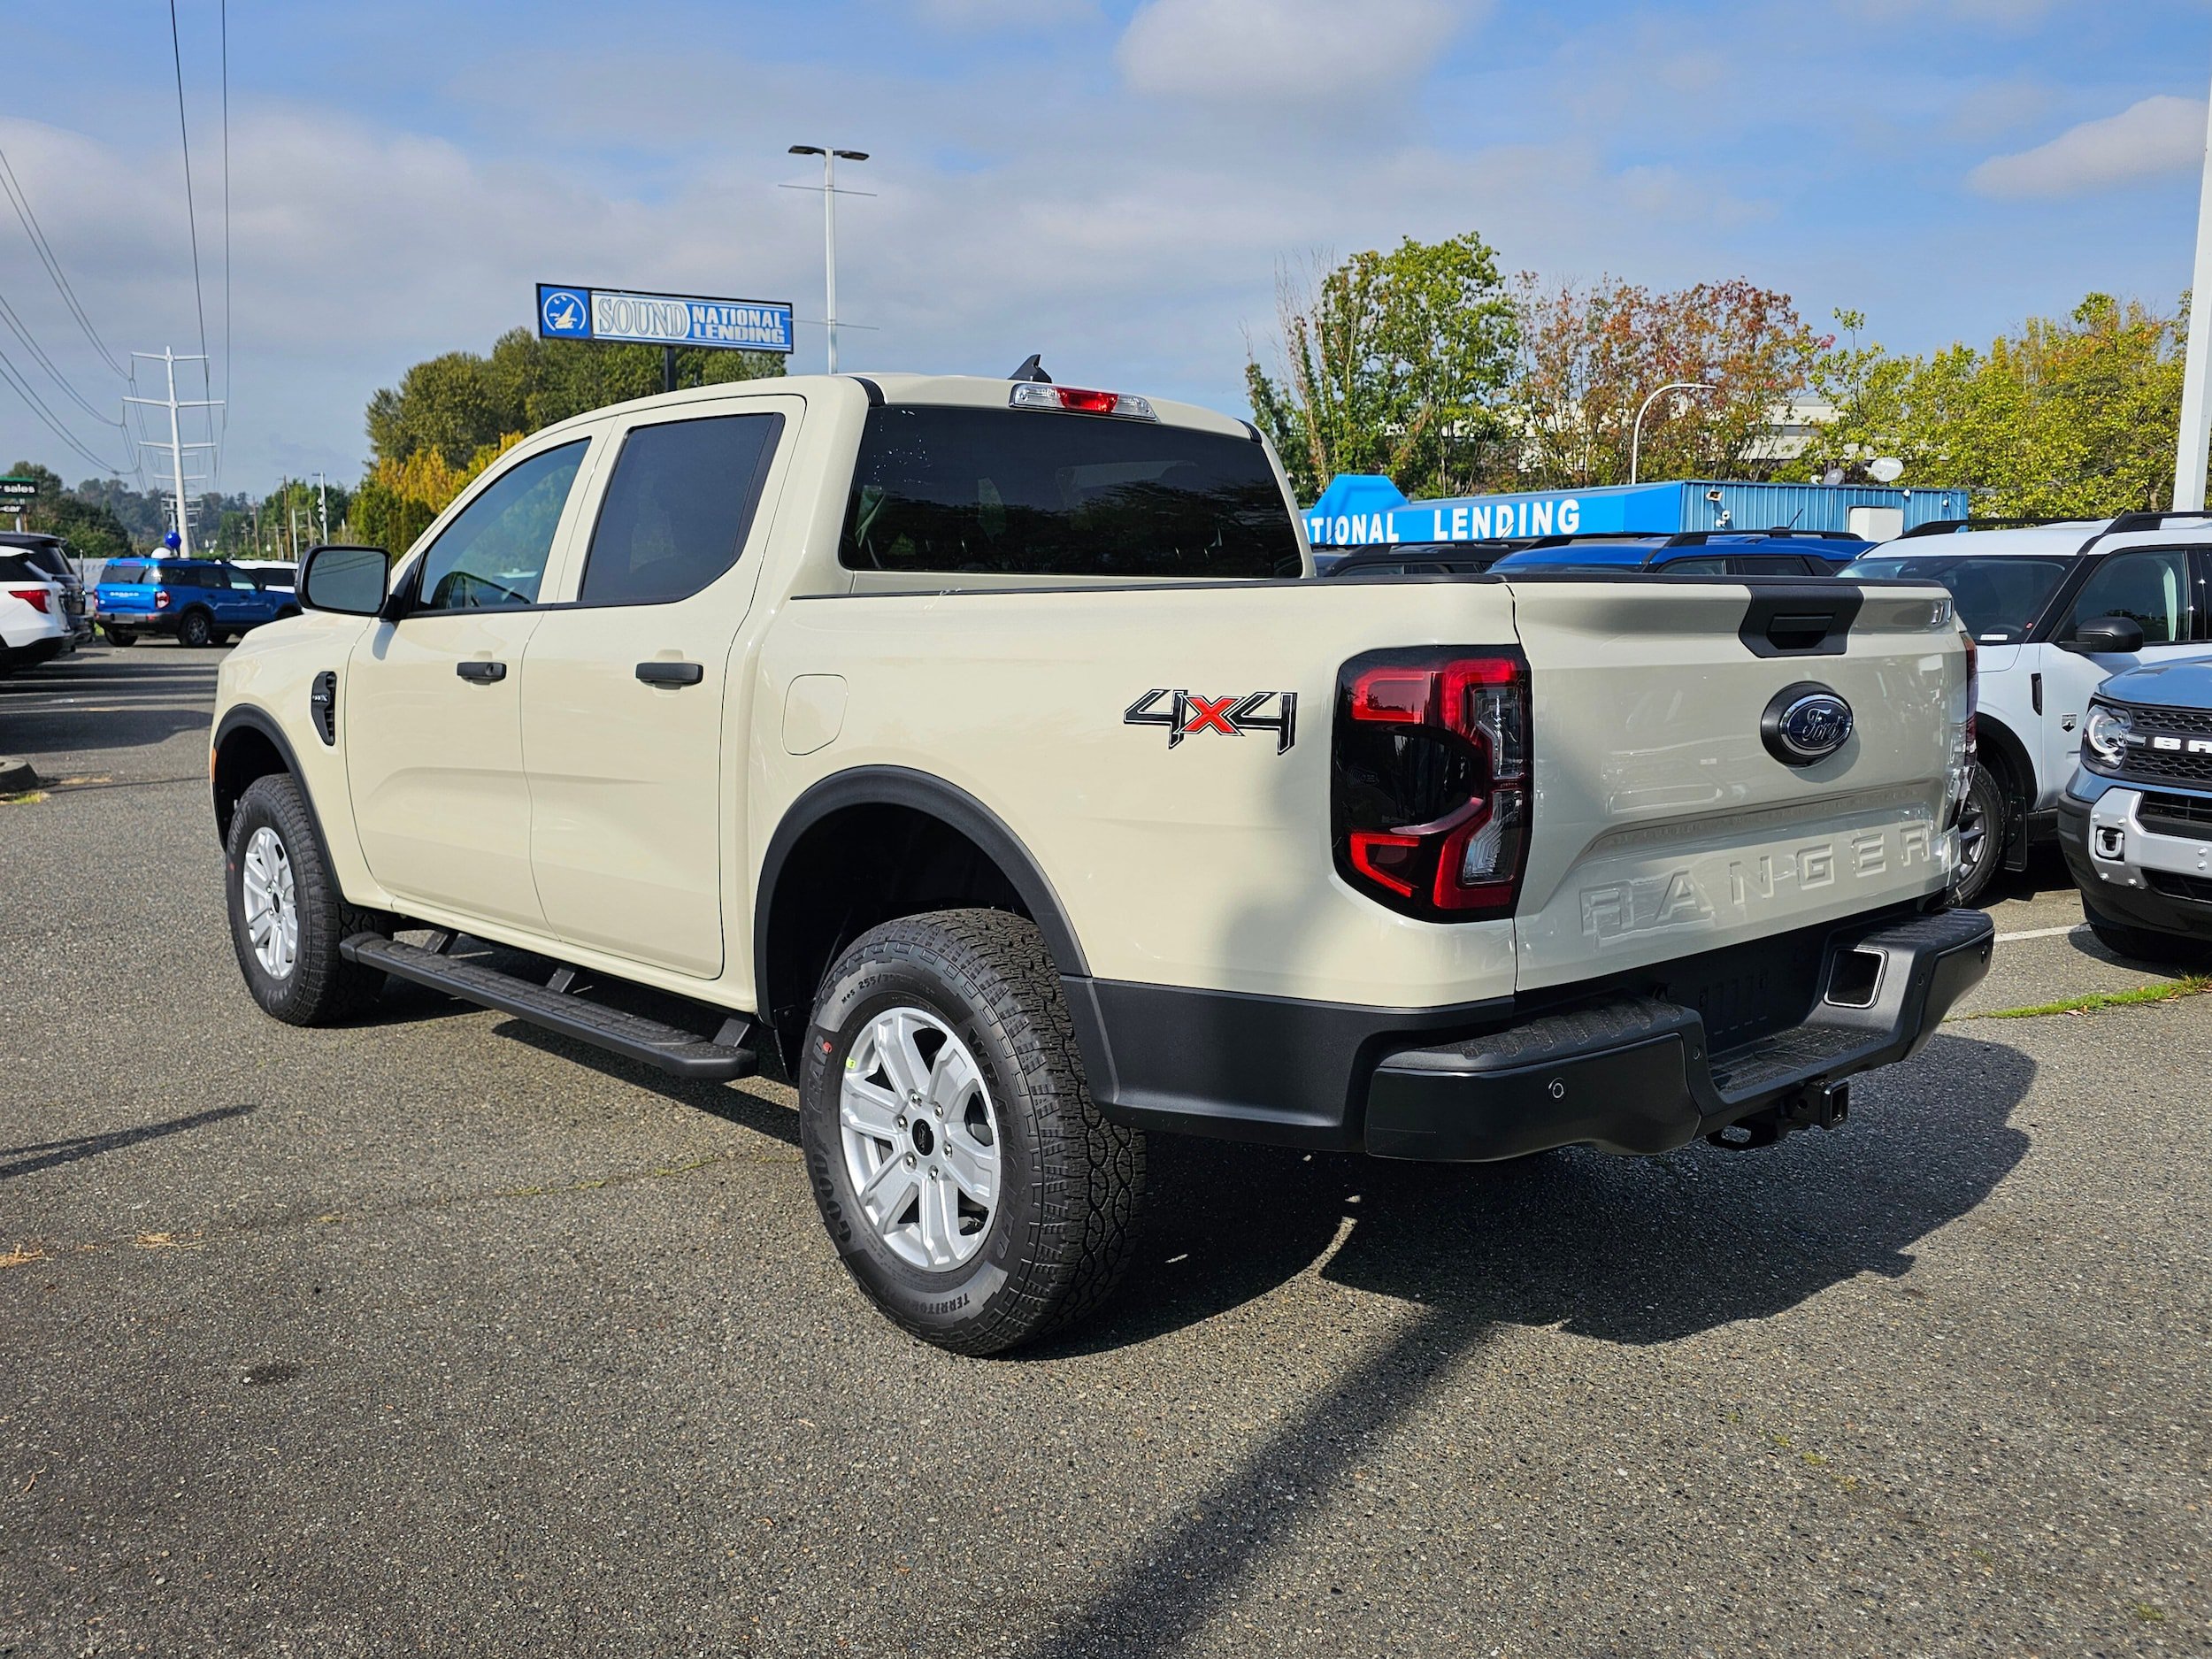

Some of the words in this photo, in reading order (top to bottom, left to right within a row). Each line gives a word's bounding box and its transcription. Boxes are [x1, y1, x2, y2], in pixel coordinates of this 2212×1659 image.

[597, 297, 687, 338] SOUND
[691, 306, 785, 329] NATIONAL
[693, 323, 786, 344] LENDING
[1433, 499, 1580, 541] LENDING
[1801, 708, 1845, 742] Ford
[1578, 820, 1932, 937] RANGER
